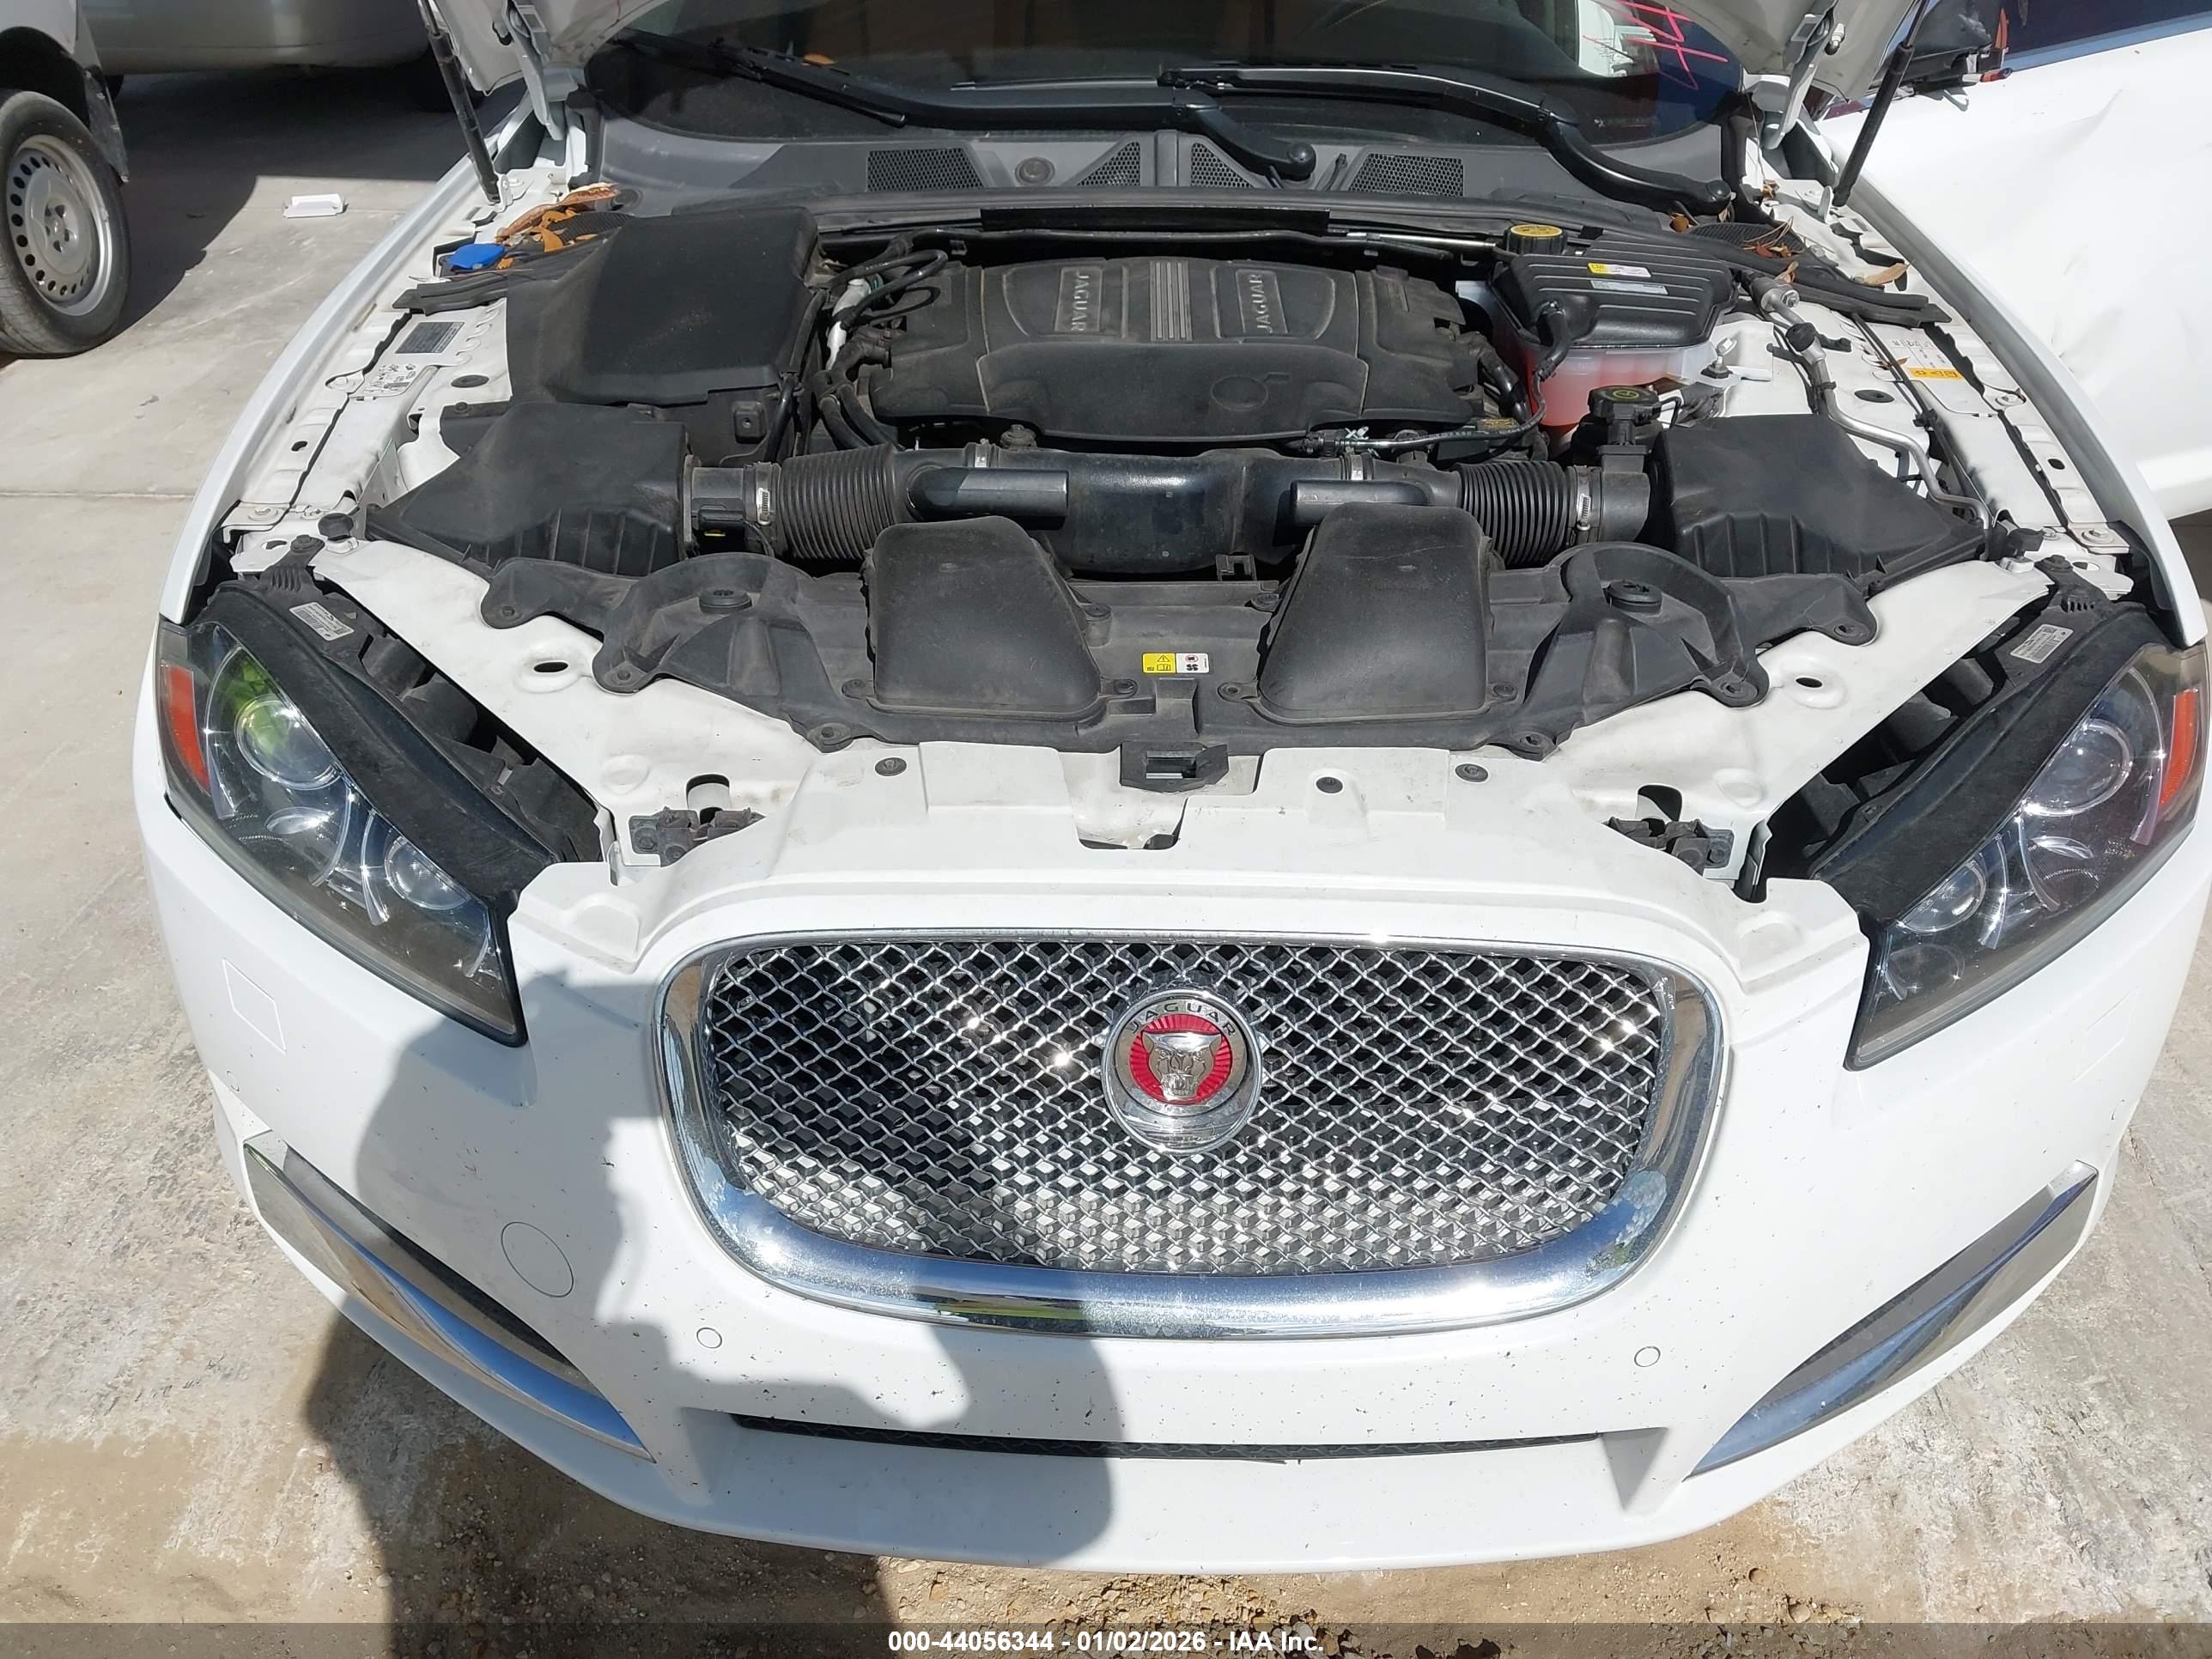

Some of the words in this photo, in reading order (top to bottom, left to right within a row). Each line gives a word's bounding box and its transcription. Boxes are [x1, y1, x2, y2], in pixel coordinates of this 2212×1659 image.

[1071, 270, 1090, 331] JAGUAR
[1248, 274, 1273, 334] JAGUAR
[1129, 1002, 1236, 1036] JAGUAR
